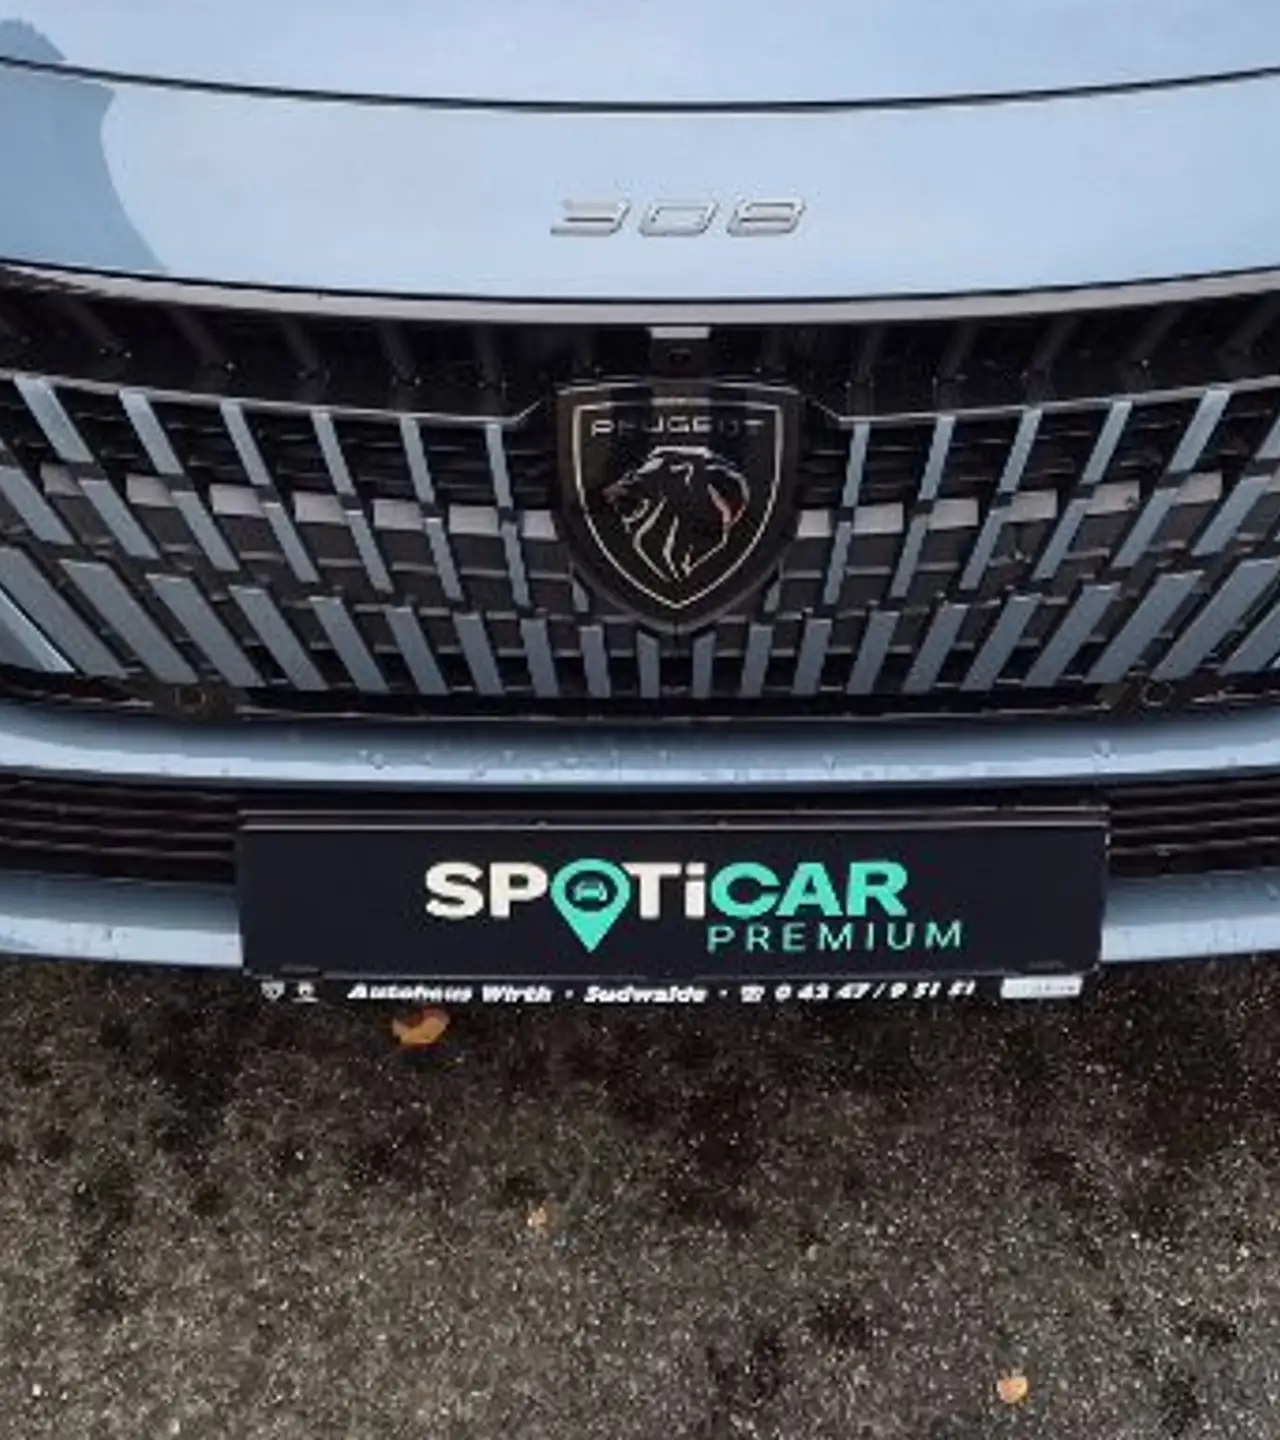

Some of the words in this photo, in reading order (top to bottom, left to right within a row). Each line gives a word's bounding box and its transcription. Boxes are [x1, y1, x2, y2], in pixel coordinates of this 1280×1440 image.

[550, 200, 806, 237] 308
[707, 920, 963, 954] PREMIUM
[347, 982, 472, 1003] Autohaus
[481, 985, 553, 1003] Wirth
